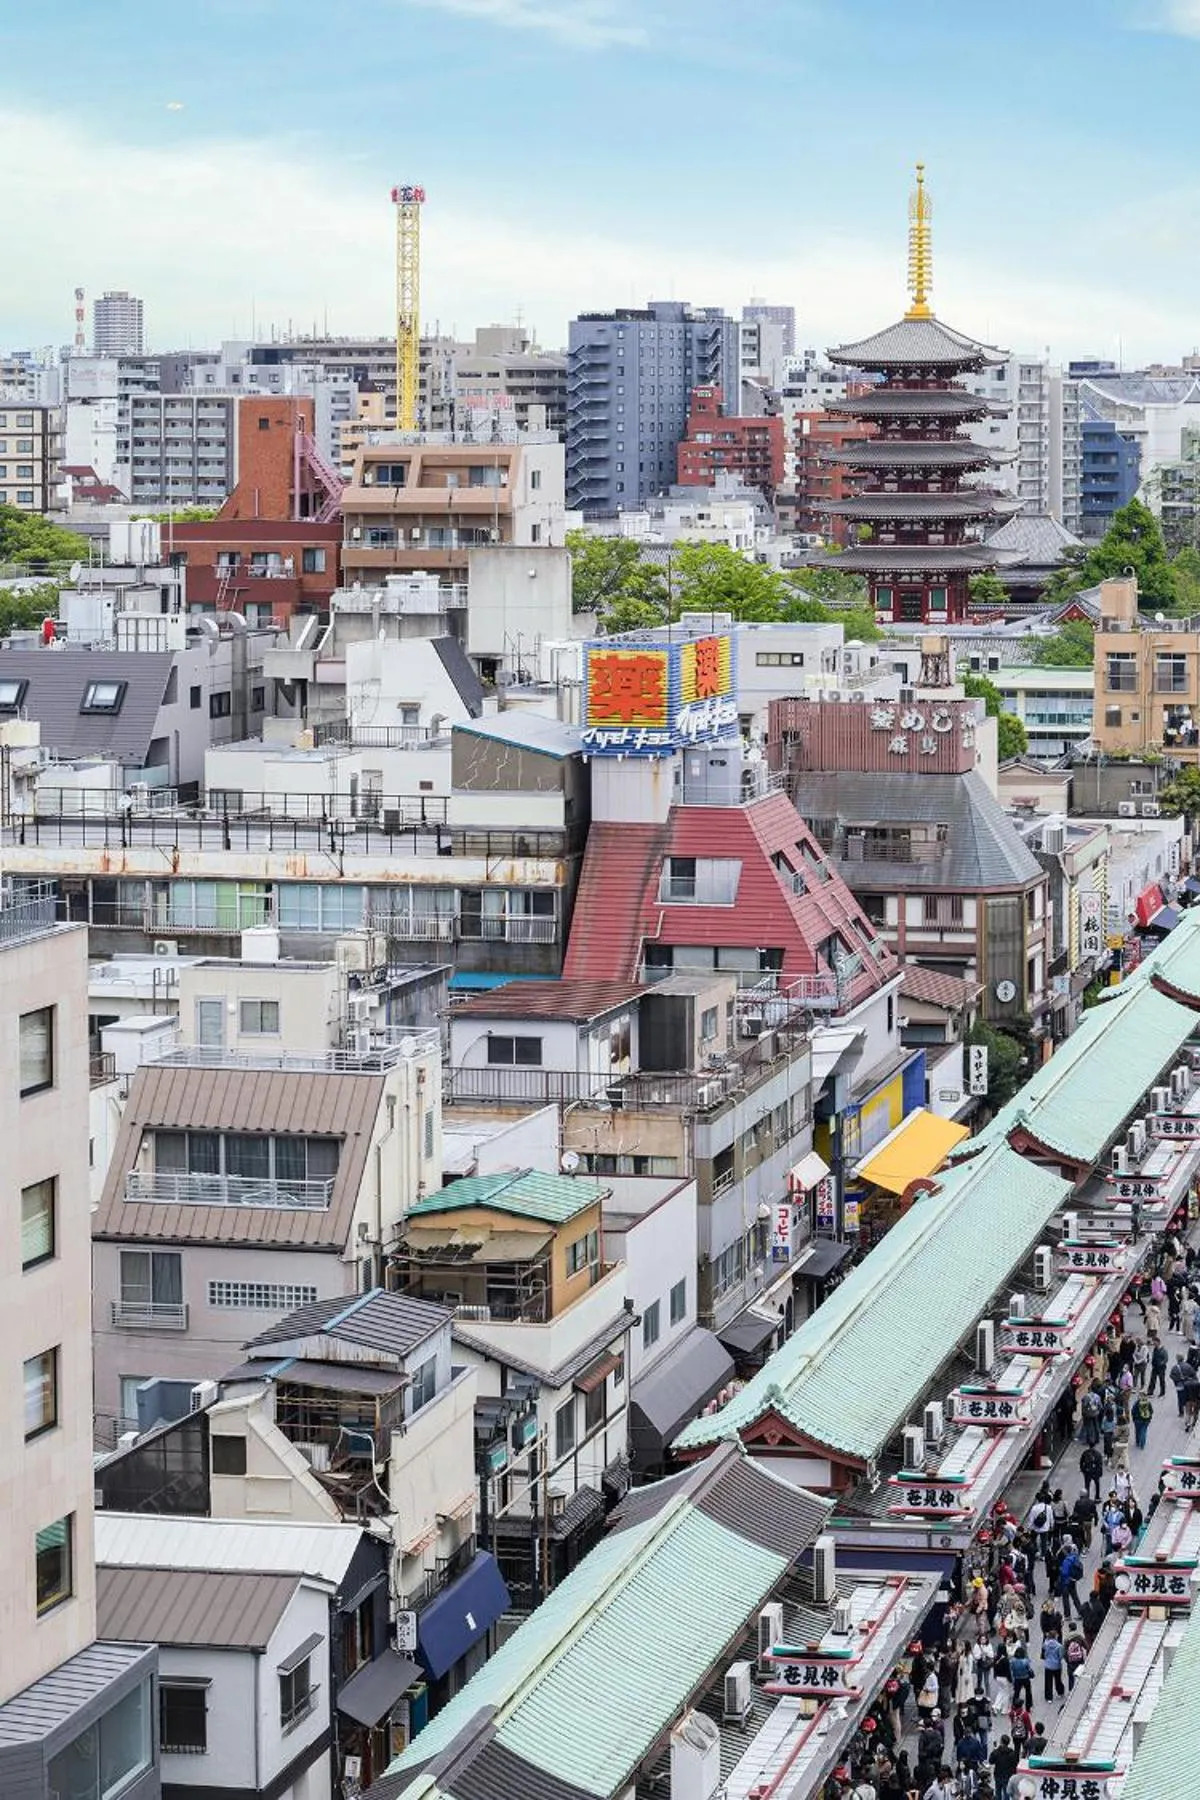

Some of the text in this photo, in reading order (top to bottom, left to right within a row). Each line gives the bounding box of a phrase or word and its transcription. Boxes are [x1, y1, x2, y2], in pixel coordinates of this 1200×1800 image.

[590, 654, 665, 721] 薬
[695, 637, 720, 698] 薬
[777, 1208, 789, 1242] コーヒー
